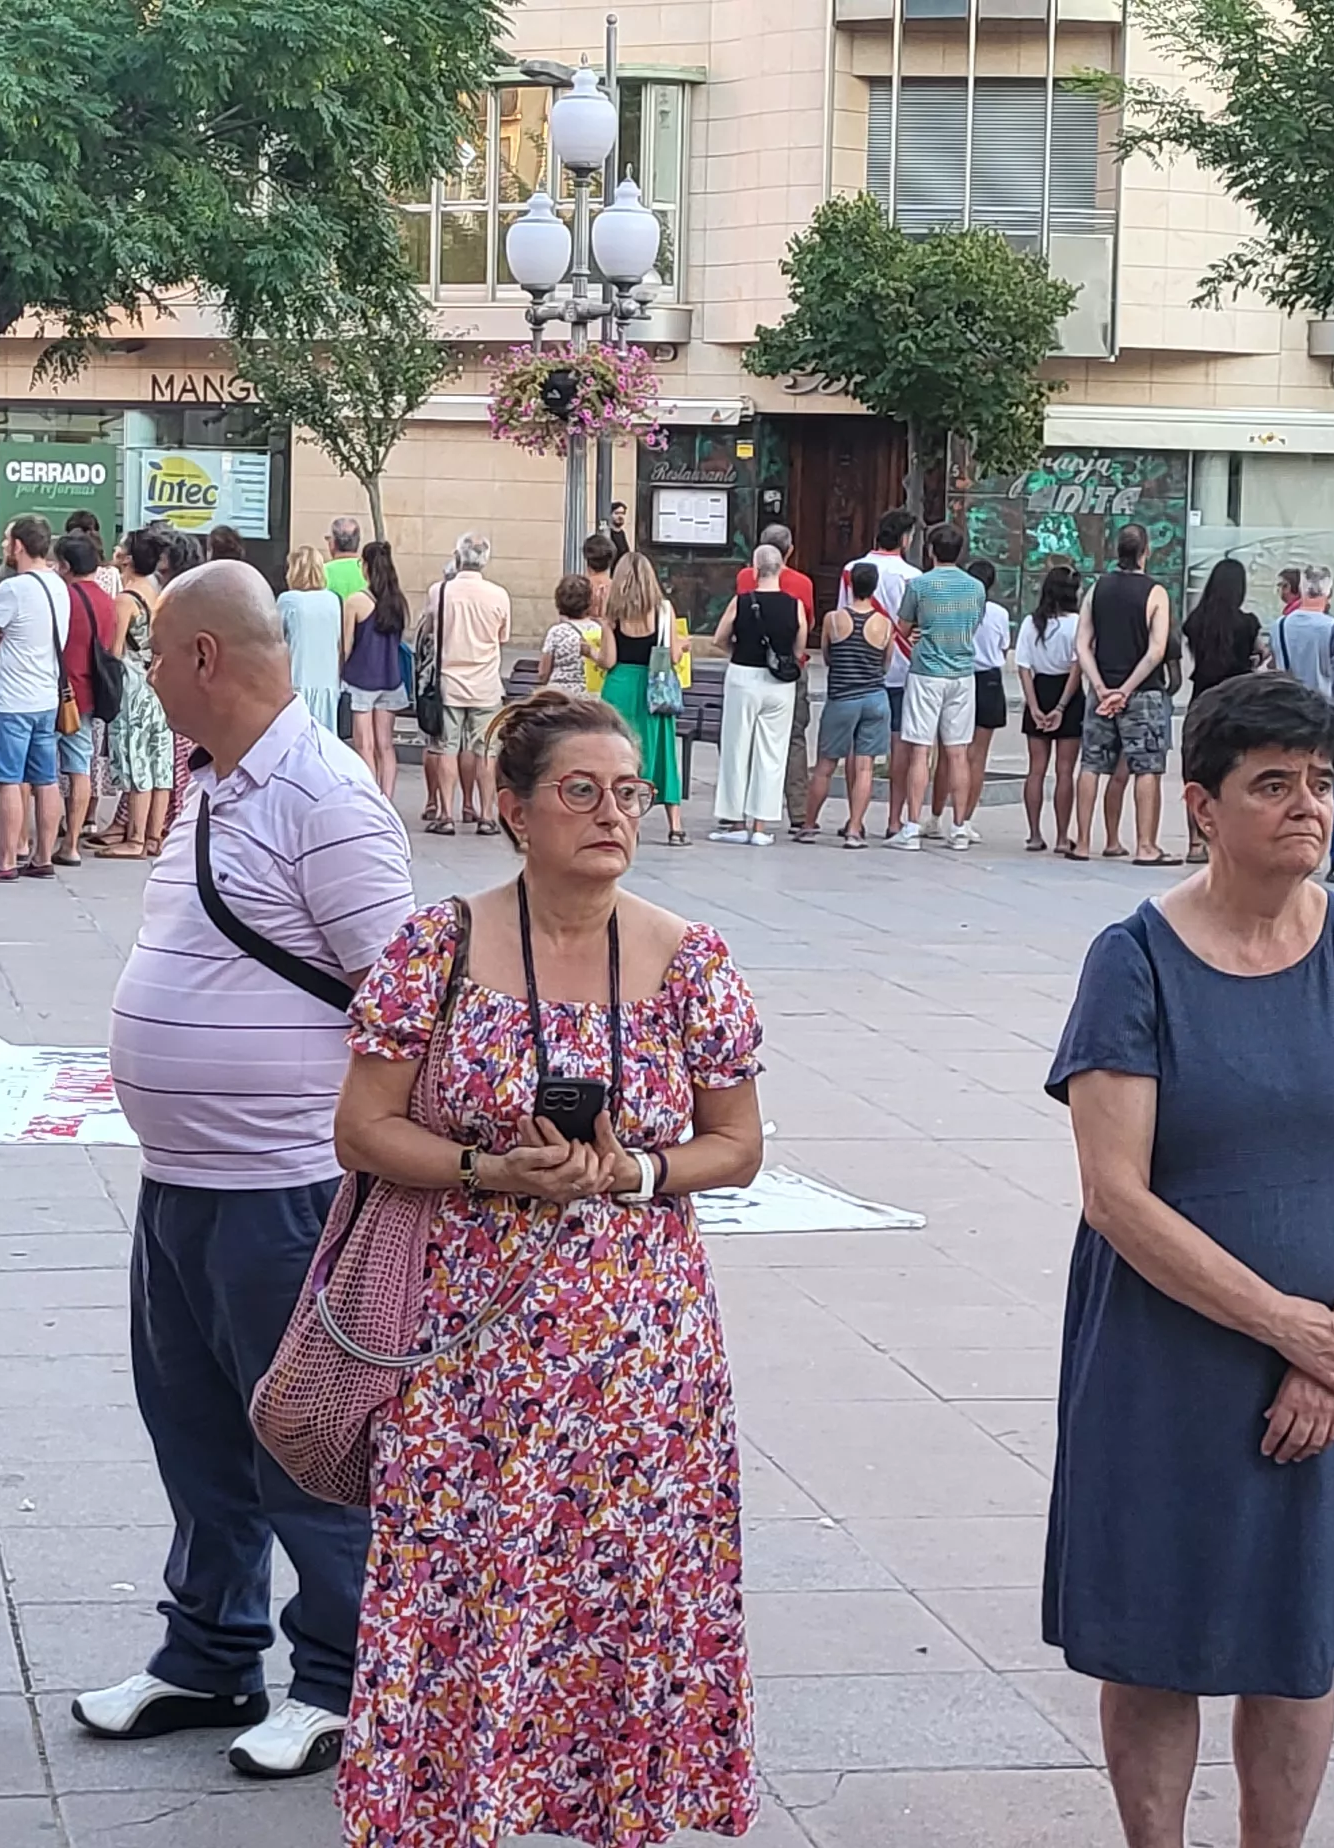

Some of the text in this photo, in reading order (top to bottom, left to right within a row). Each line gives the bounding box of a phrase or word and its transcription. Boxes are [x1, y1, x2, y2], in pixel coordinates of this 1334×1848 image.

[151, 374, 261, 402] MANG
[6, 461, 106, 485] CERRADO
[651, 461, 737, 482] Restaurante
[15, 482, 96, 499] por reformas
